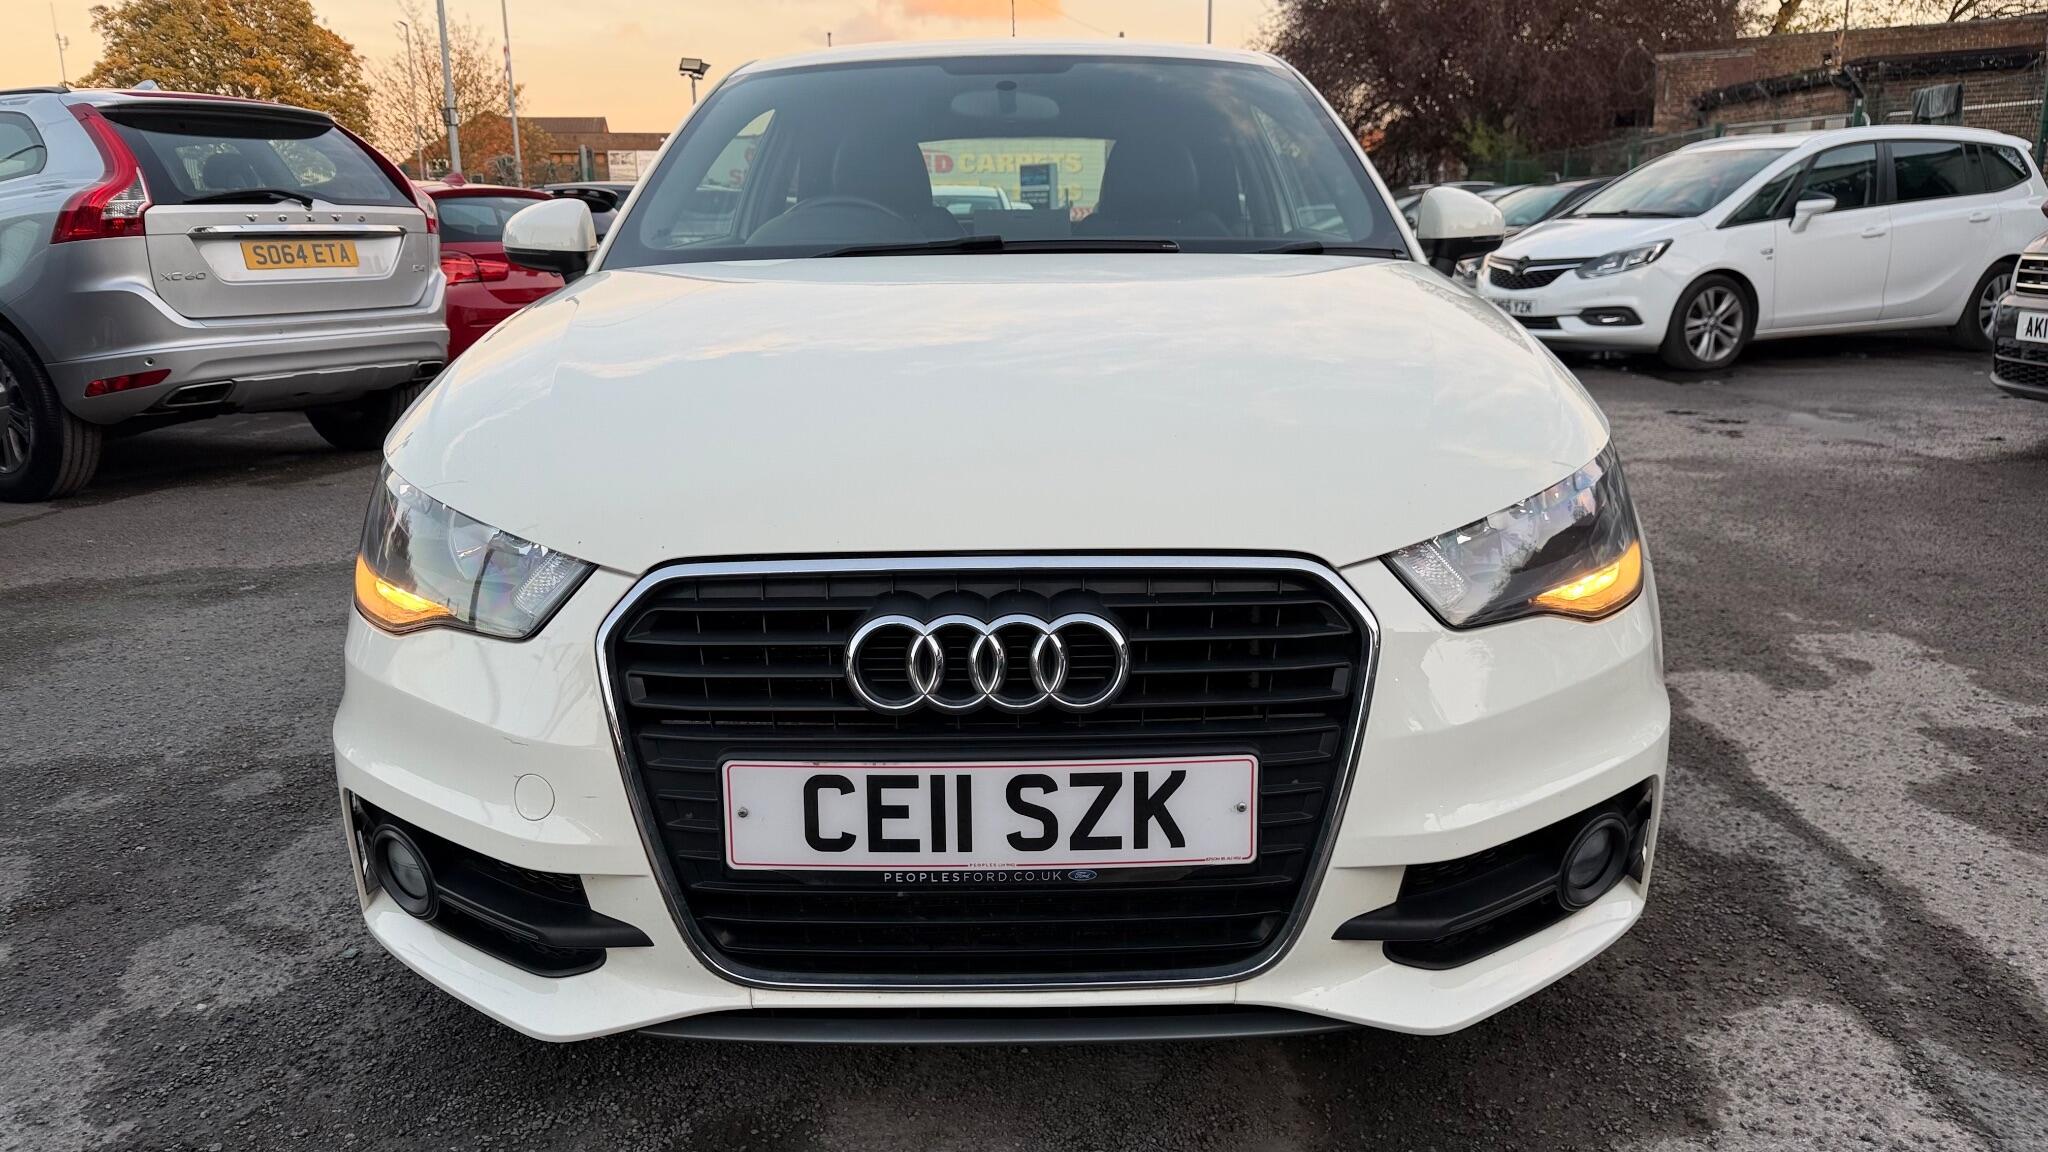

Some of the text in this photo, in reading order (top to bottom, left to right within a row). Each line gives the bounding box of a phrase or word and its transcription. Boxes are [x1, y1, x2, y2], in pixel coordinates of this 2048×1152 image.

[957, 152, 1083, 173] CARPETS
[246, 214, 366, 222] VOLVO
[311, 243, 351, 263] ETA
[160, 271, 206, 281] XC60
[804, 770, 1187, 852] CE11 SZK
[884, 871, 1062, 882] PEOPLESFORD.CO.UK
